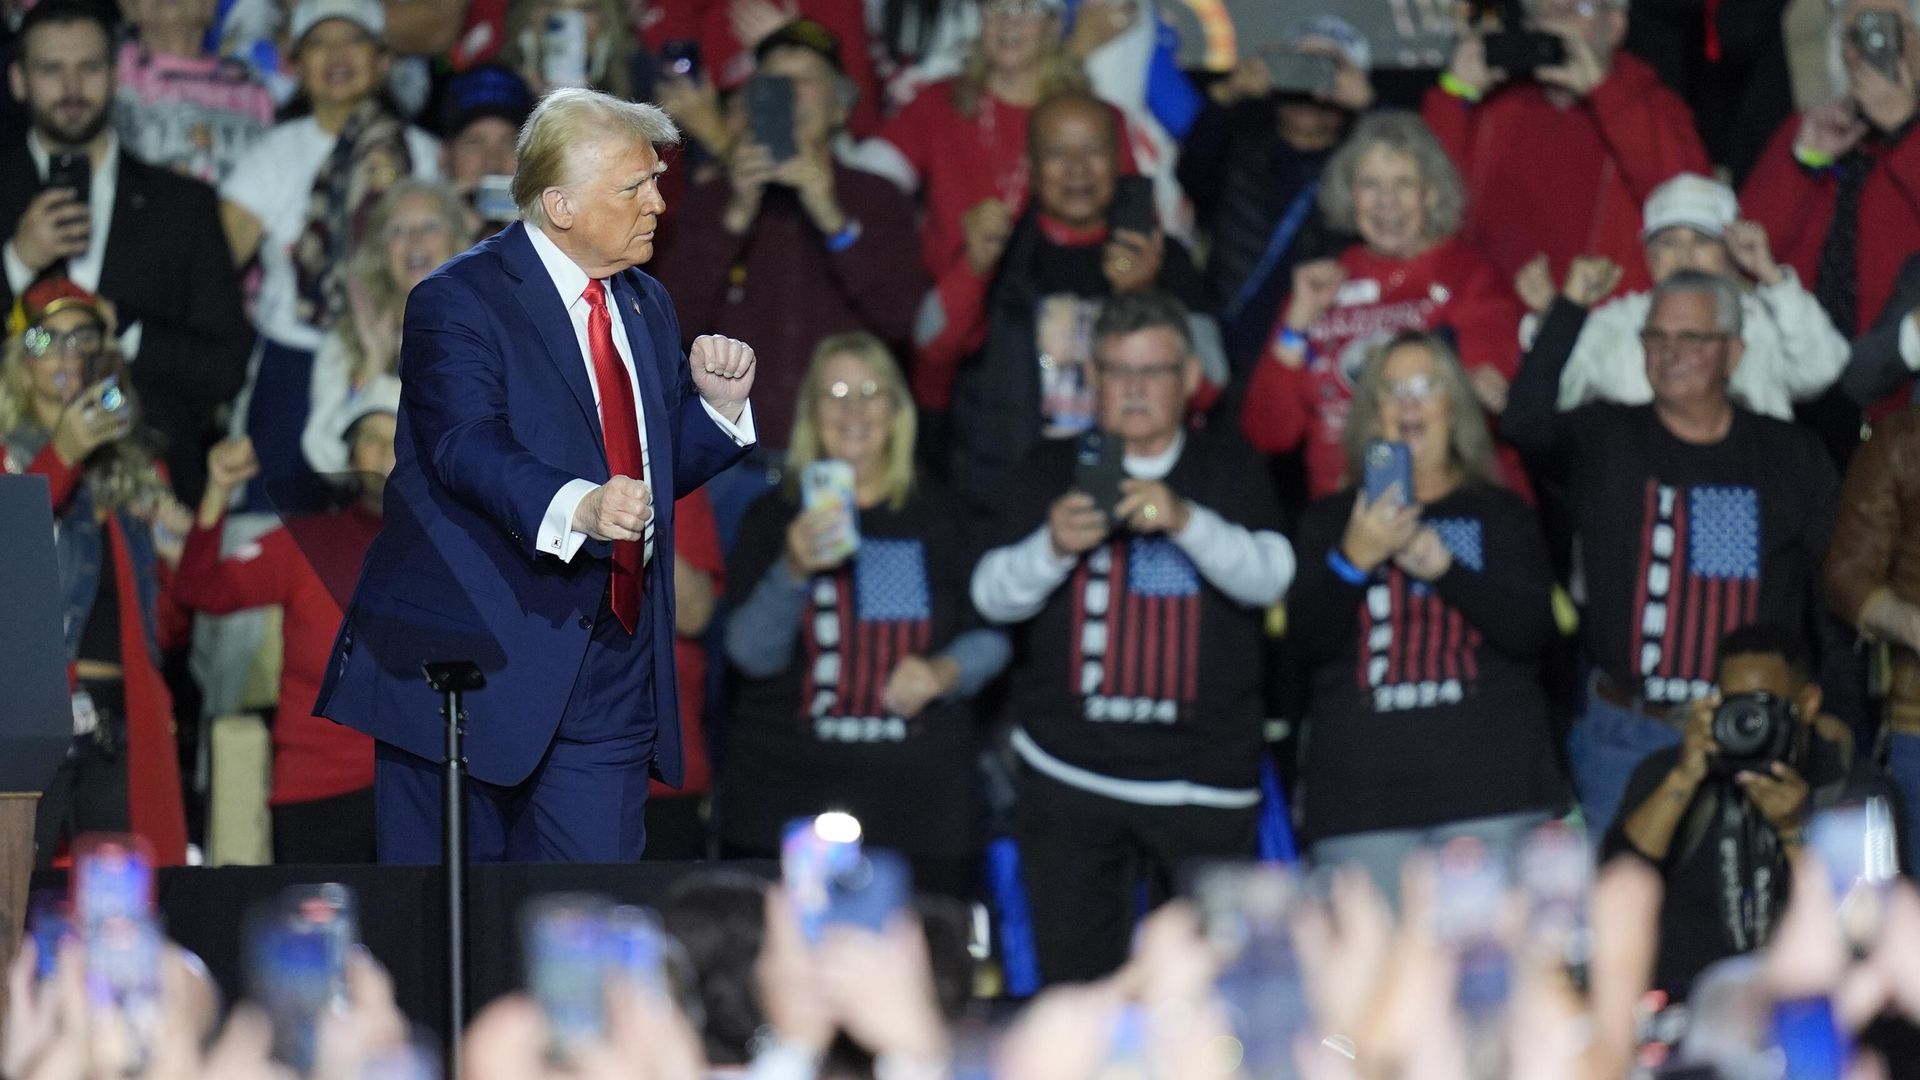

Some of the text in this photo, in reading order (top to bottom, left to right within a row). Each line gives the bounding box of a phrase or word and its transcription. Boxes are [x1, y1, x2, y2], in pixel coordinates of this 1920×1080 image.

[1081, 547, 1111, 694] RUMP
[1640, 485, 1675, 676] TRUMP
[811, 577, 841, 717] RUMP
[815, 717, 906, 741] 2024
[1086, 697, 1177, 722] 2024
[1374, 680, 1462, 712] 2024
